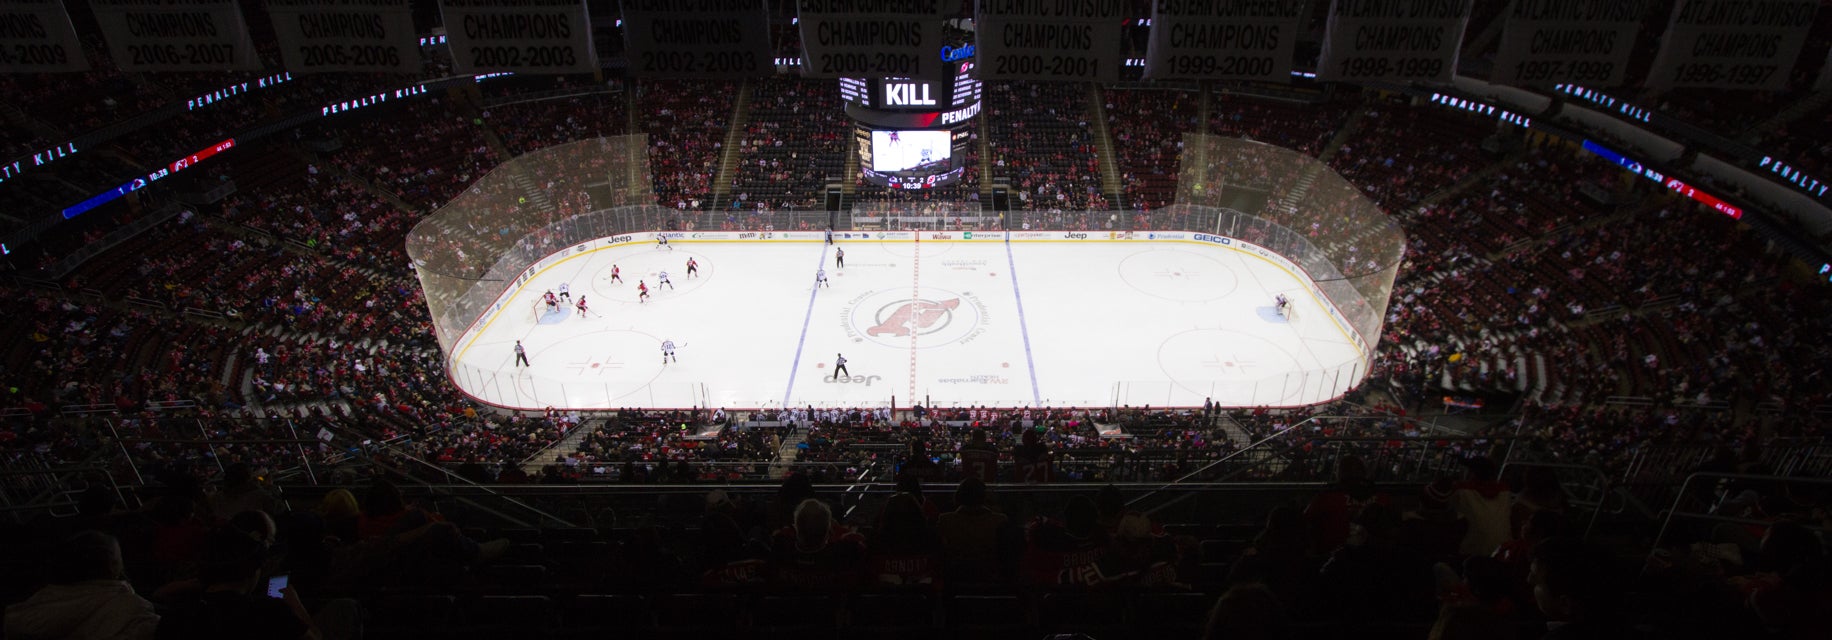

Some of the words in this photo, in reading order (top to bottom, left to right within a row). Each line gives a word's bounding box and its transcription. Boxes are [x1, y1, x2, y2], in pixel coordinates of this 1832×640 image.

[125, 12, 217, 38] CHAMPIONS
[300, 13, 385, 40] CHAMPIONS
[463, 13, 571, 40] CHAMPIONS
[652, 18, 742, 45] CHAMPIONS
[818, 20, 922, 47] CHAMPIONS
[1003, 23, 1092, 50] CHAMPIONS
[1170, 23, 1279, 50] CHAMPIONS
[1355, 25, 1444, 51] CHAMPIONS
[1531, 29, 1617, 54] CHAMPIONS
[1692, 32, 1782, 58] CHAMPIONS
[127, 43, 234, 65] 2006-2007
[302, 44, 401, 67] 2005-2006
[471, 46, 576, 68] 2002-2003
[641, 50, 757, 73] 2002-2003
[774, 57, 801, 65] KILL
[821, 53, 919, 74] 2000-2001
[996, 55, 1098, 77] 2000-2001
[1167, 55, 1274, 76] 1999-2000
[1341, 57, 1443, 77] 1998-1999
[1515, 60, 1614, 81] 1997-1998
[1673, 63, 1778, 85] 1996-1997
[188, 82, 248, 110] PENALTY
[259, 71, 292, 88] KILL
[322, 92, 387, 116] PENALTY
[396, 84, 427, 99] KILL
[885, 83, 936, 105] KILL
[941, 103, 978, 124] PENALTY
[1432, 93, 1495, 116] PENALTY
[1500, 110, 1530, 128] KILL
[1620, 103, 1651, 122] KILL
[34, 142, 77, 165] KILL
[149, 168, 168, 181] 10:39
[192, 155, 199, 163] 2
[1760, 156, 1828, 196] PENALTY
[1687, 188, 1695, 197] 2
[608, 234, 632, 244] Jeep
[1065, 232, 1087, 240] Jeep
[1194, 234, 1231, 245] GEICO
[823, 375, 882, 386] Jeep
[1022, 463, 1048, 484] 27
